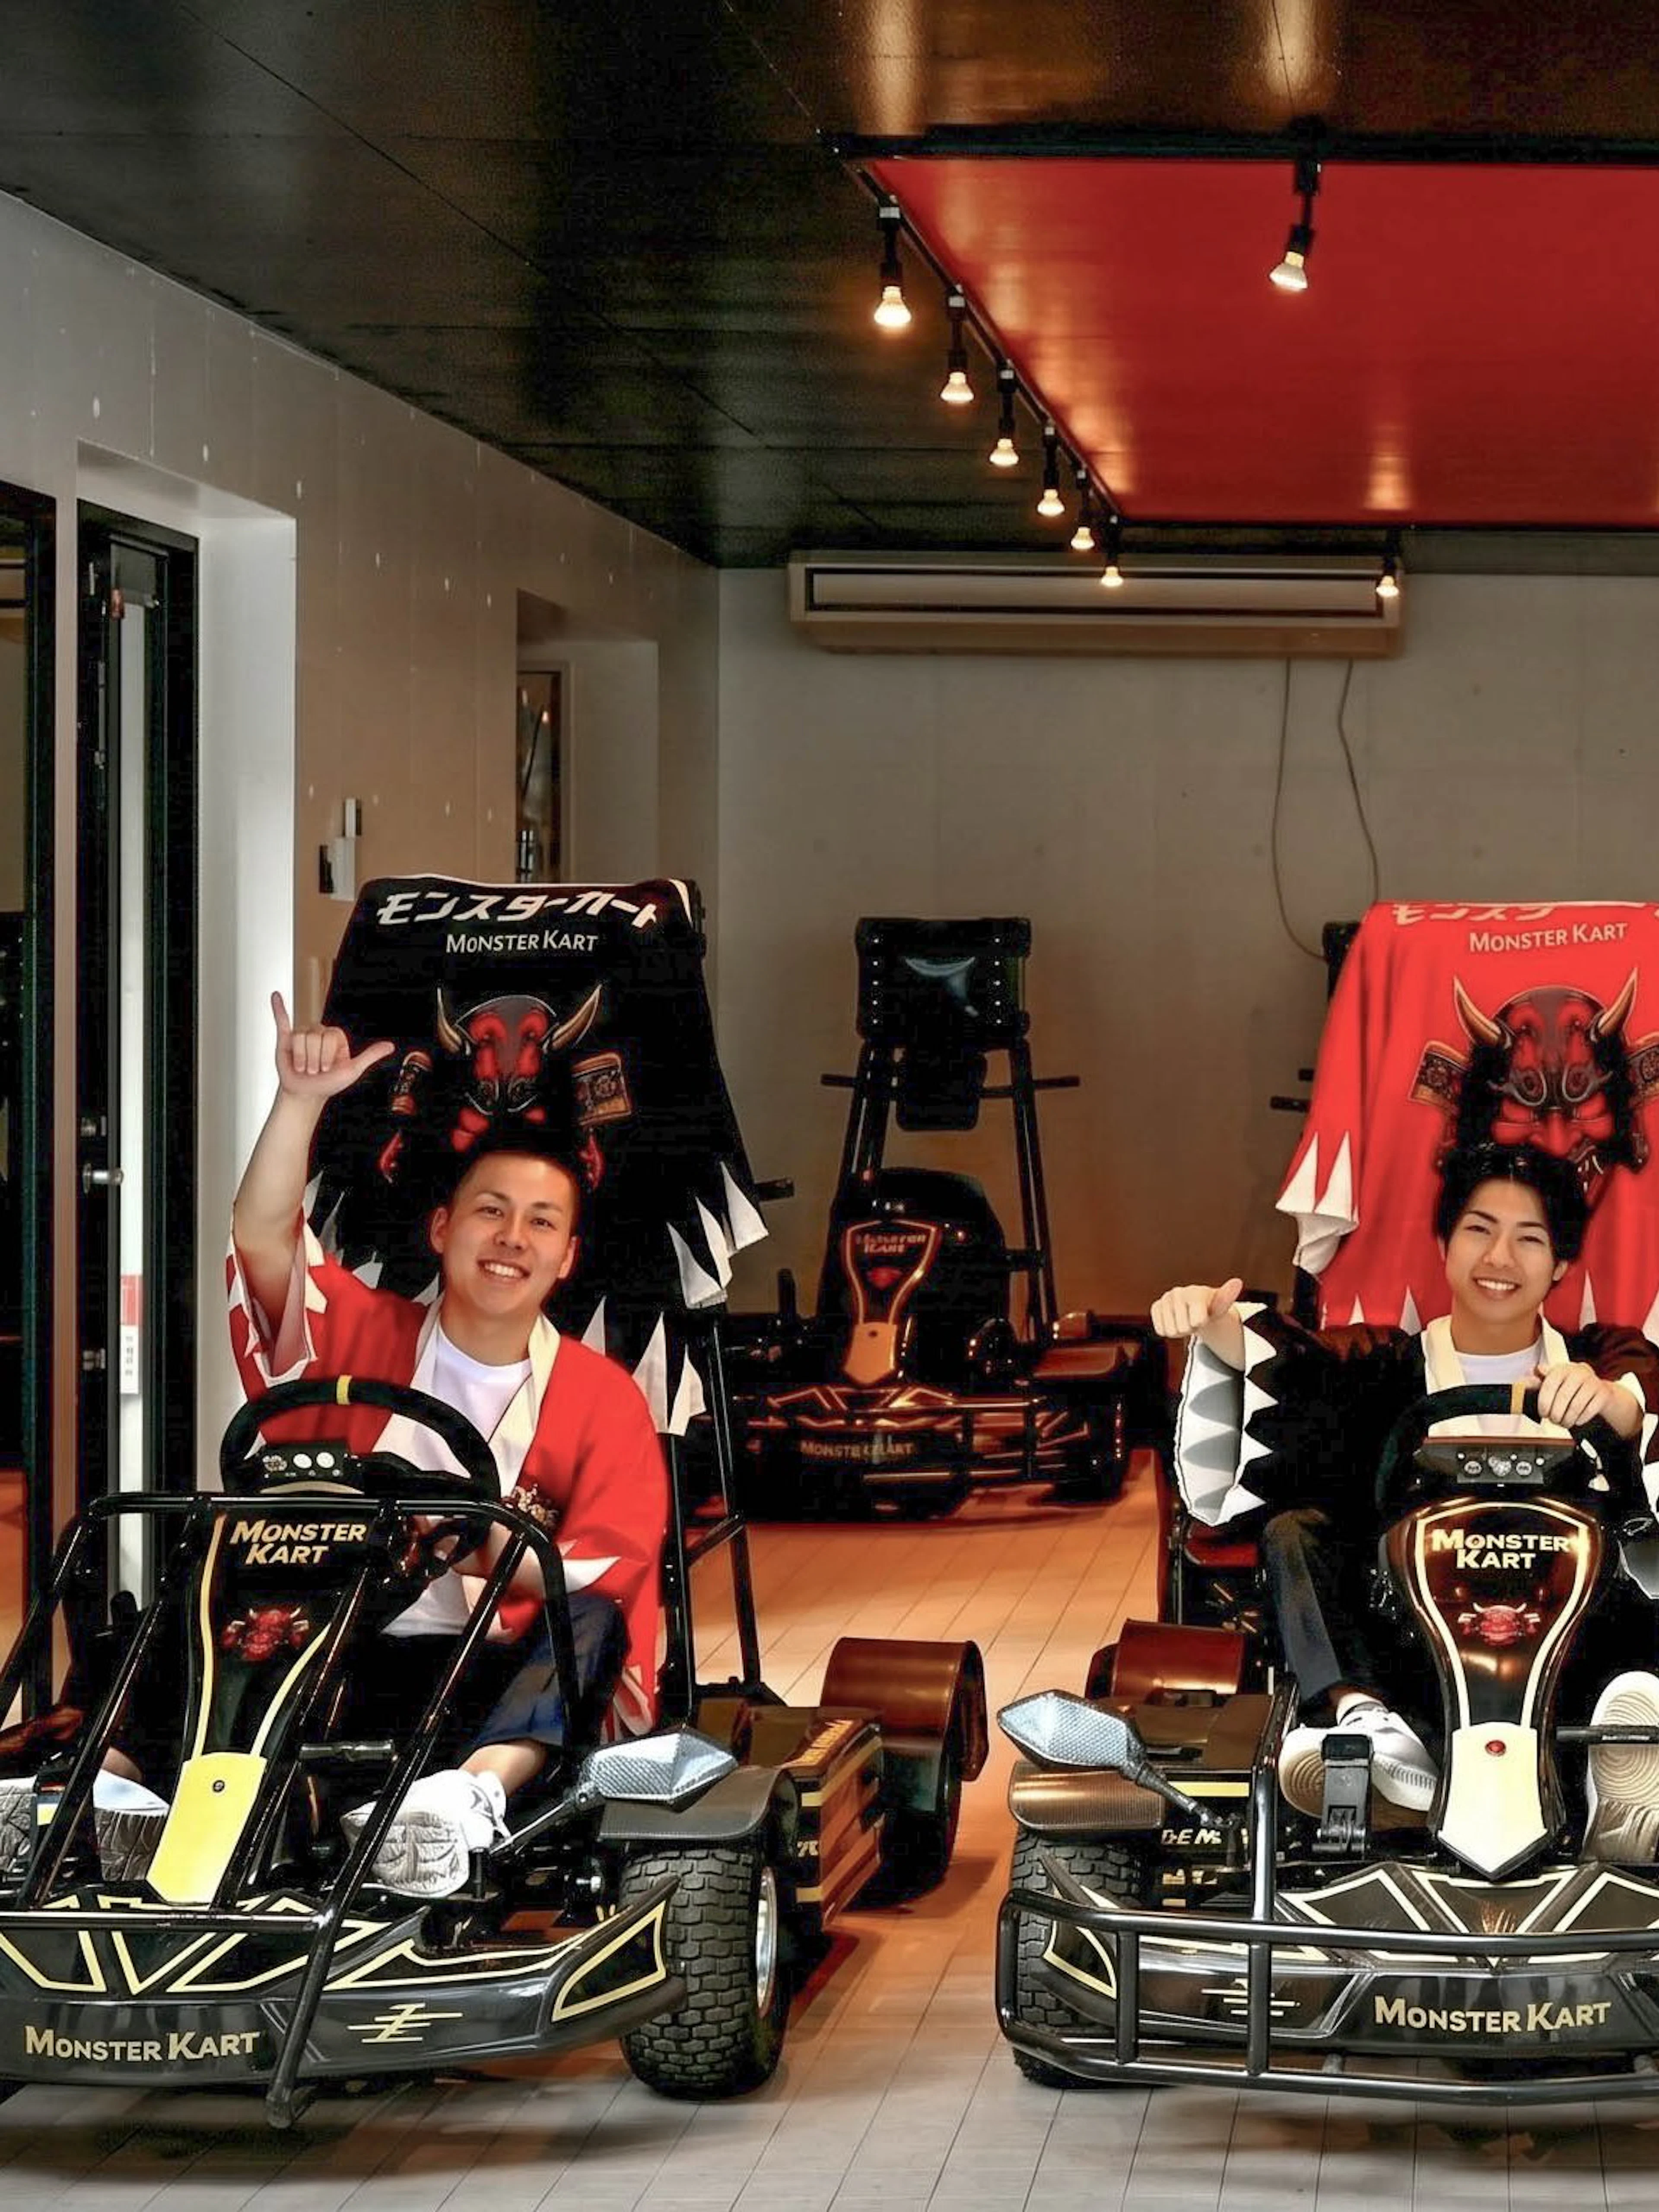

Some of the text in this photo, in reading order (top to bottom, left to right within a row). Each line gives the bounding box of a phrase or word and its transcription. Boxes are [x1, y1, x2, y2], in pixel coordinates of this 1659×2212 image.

[446, 929, 599, 953] MONSTER KART
[1469, 922, 1628, 953] MONSTER KART
[229, 1519, 367, 1545] MONSTER
[1431, 1528, 1571, 1553] MONSTER
[245, 1543, 330, 1565] KART
[1456, 1549, 1536, 1569] KART
[1374, 1995, 1611, 2033] MONSTER KART
[25, 2025, 259, 2062] MONSTER KART
